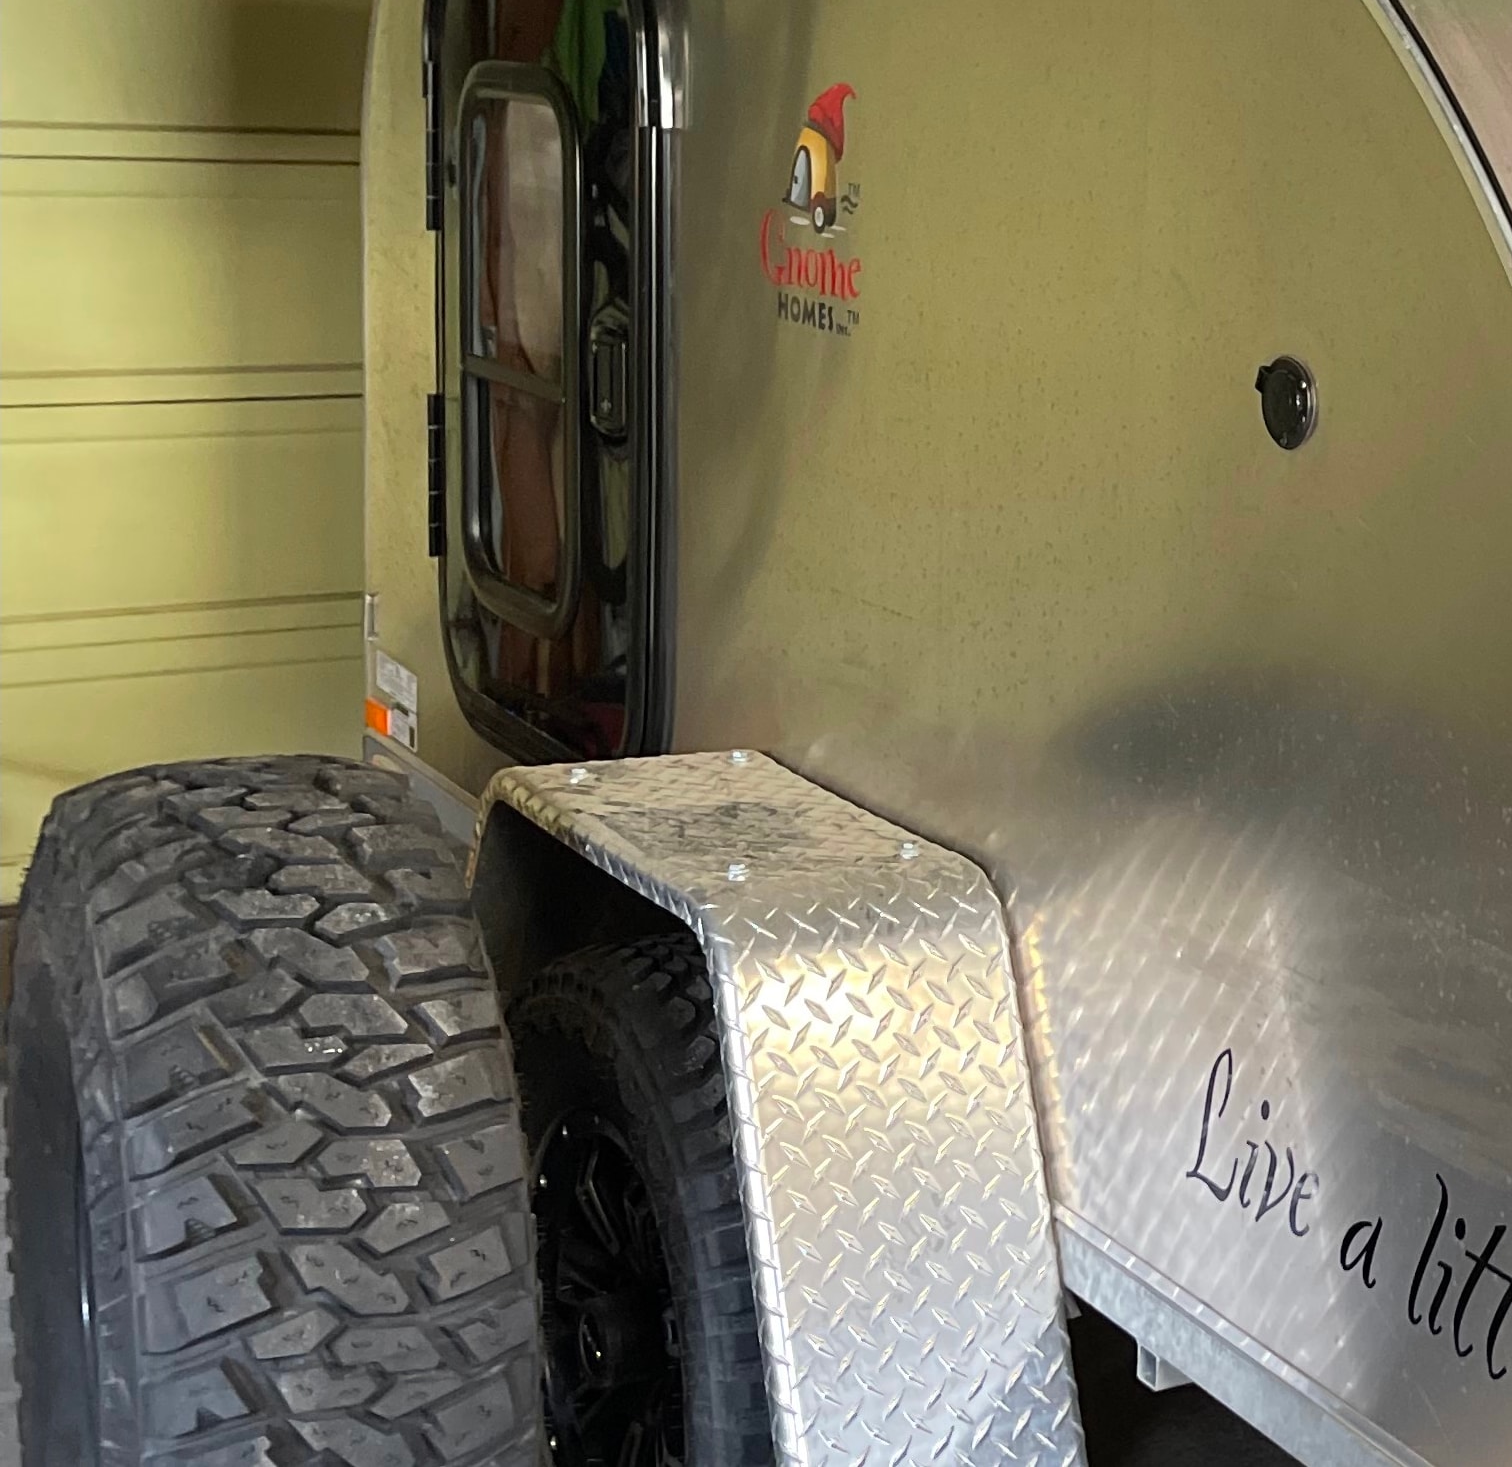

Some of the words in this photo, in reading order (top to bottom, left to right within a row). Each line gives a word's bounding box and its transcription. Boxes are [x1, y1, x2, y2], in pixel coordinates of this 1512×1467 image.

[760, 208, 862, 301] Gnome
[777, 291, 834, 332] HOMES
[1185, 1048, 1320, 1237] Live
[1340, 1216, 1384, 1289] a
